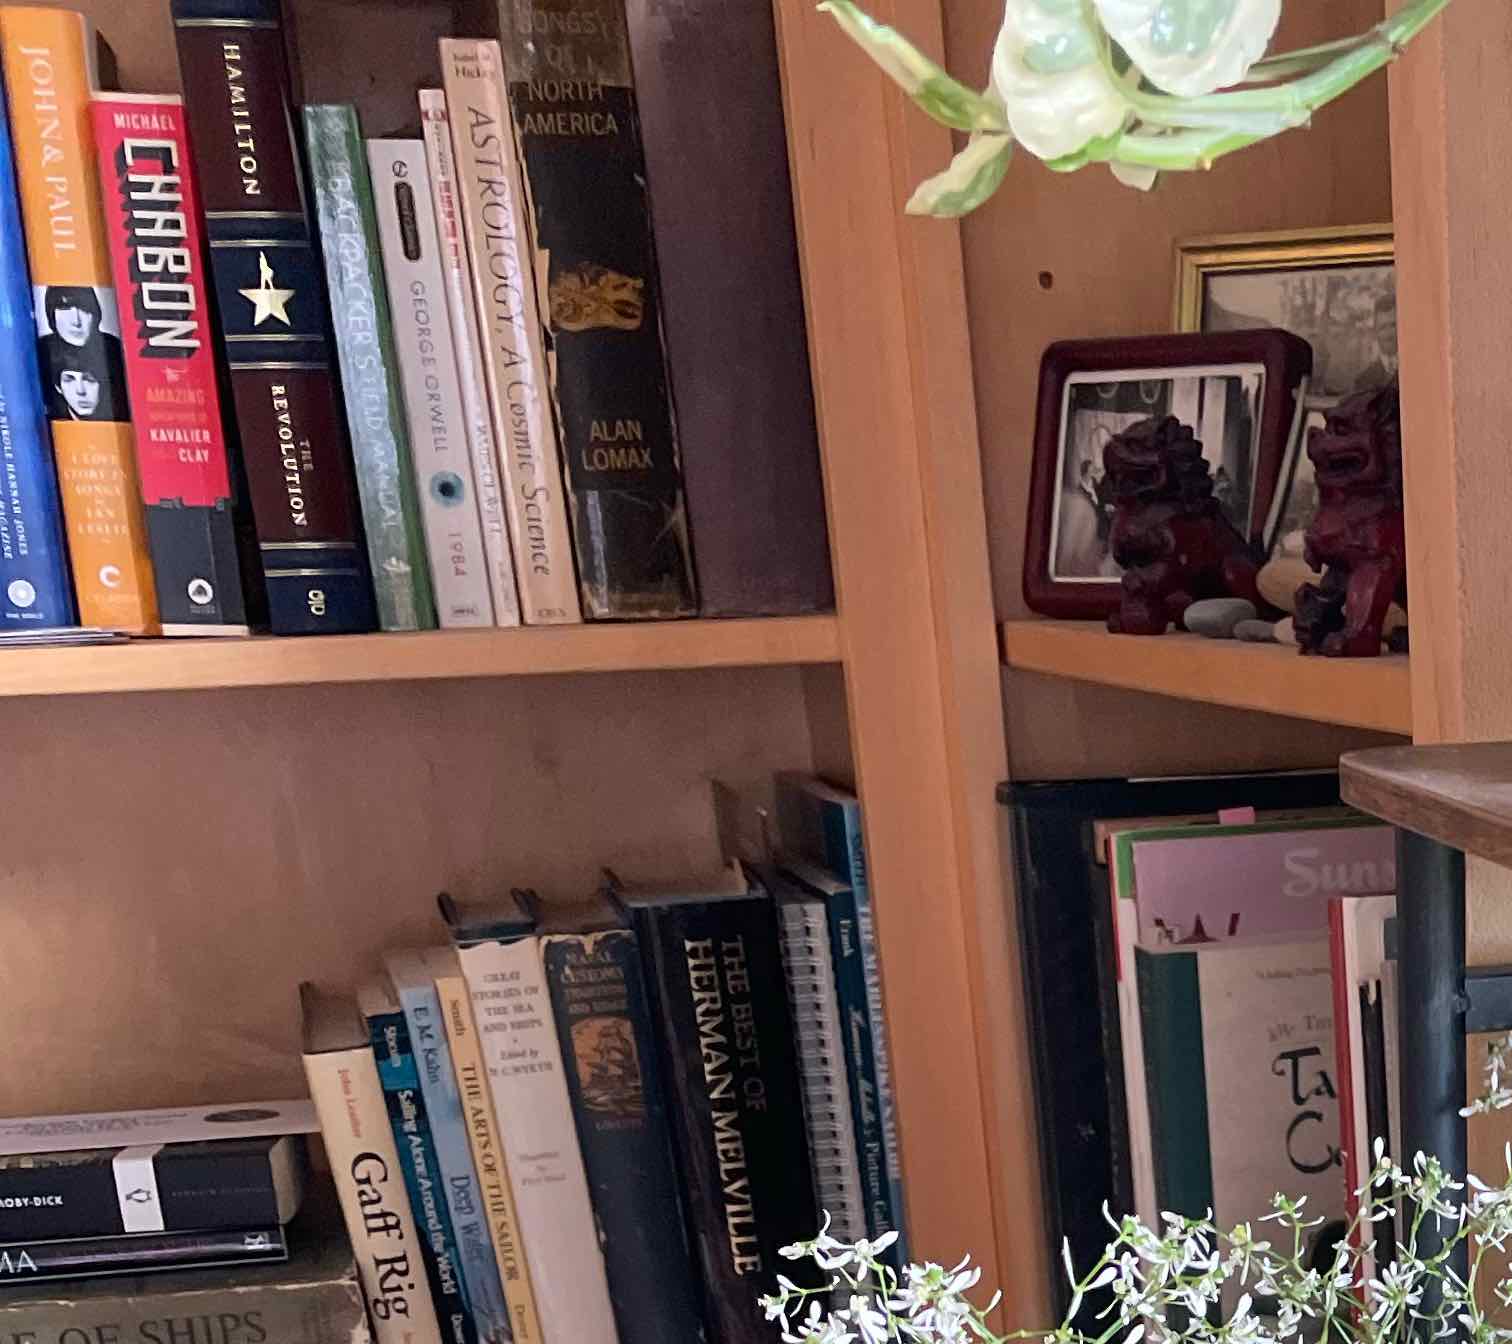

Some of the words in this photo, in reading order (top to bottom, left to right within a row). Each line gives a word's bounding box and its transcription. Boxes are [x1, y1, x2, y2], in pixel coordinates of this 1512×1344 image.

[527, 79, 603, 102] NORTH
[111, 111, 177, 131] MICHAEL
[222, 43, 262, 196] HAMILTON
[522, 111, 620, 136] AMERICA
[19, 45, 64, 140] JOHN
[44, 175, 77, 257] PAUL
[120, 137, 201, 351] CHABON
[409, 279, 437, 366] GEORGE
[423, 373, 450, 454] ORWELL
[149, 427, 212, 444] KAVALIER
[589, 419, 643, 443] ALAN
[178, 447, 210, 464] CLAY
[271, 383, 308, 528] REVOLUTION
[501, 347, 528, 368] A
[520, 485, 551, 576] Science
[581, 447, 654, 472] LOMAX
[447, 532, 468, 577] 1984
[1282, 847, 1396, 897] Sun
[721, 934, 751, 995] THE
[472, 987, 522, 1002] STORIES
[524, 985, 540, 996] OF
[484, 1006, 508, 1017] THE
[730, 1004, 762, 1067] BEST
[461, 1064, 482, 1097] THE
[744, 1078, 768, 1113] OF
[471, 1106, 493, 1150] ARTS
[683, 938, 737, 1100] HERMAN
[711, 1110, 763, 1277] MELVILLE
[408, 1134, 430, 1178] Alone
[480, 1151, 497, 1173] OF
[351, 1151, 405, 1241] Gaff
[418, 1178, 446, 1230] Around
[450, 1175, 477, 1216] Deep
[487, 1183, 507, 1213] THE
[497, 1223, 521, 1281] SAILOR
[371, 1252, 416, 1321] Rig
[436, 1254, 458, 1296] World
